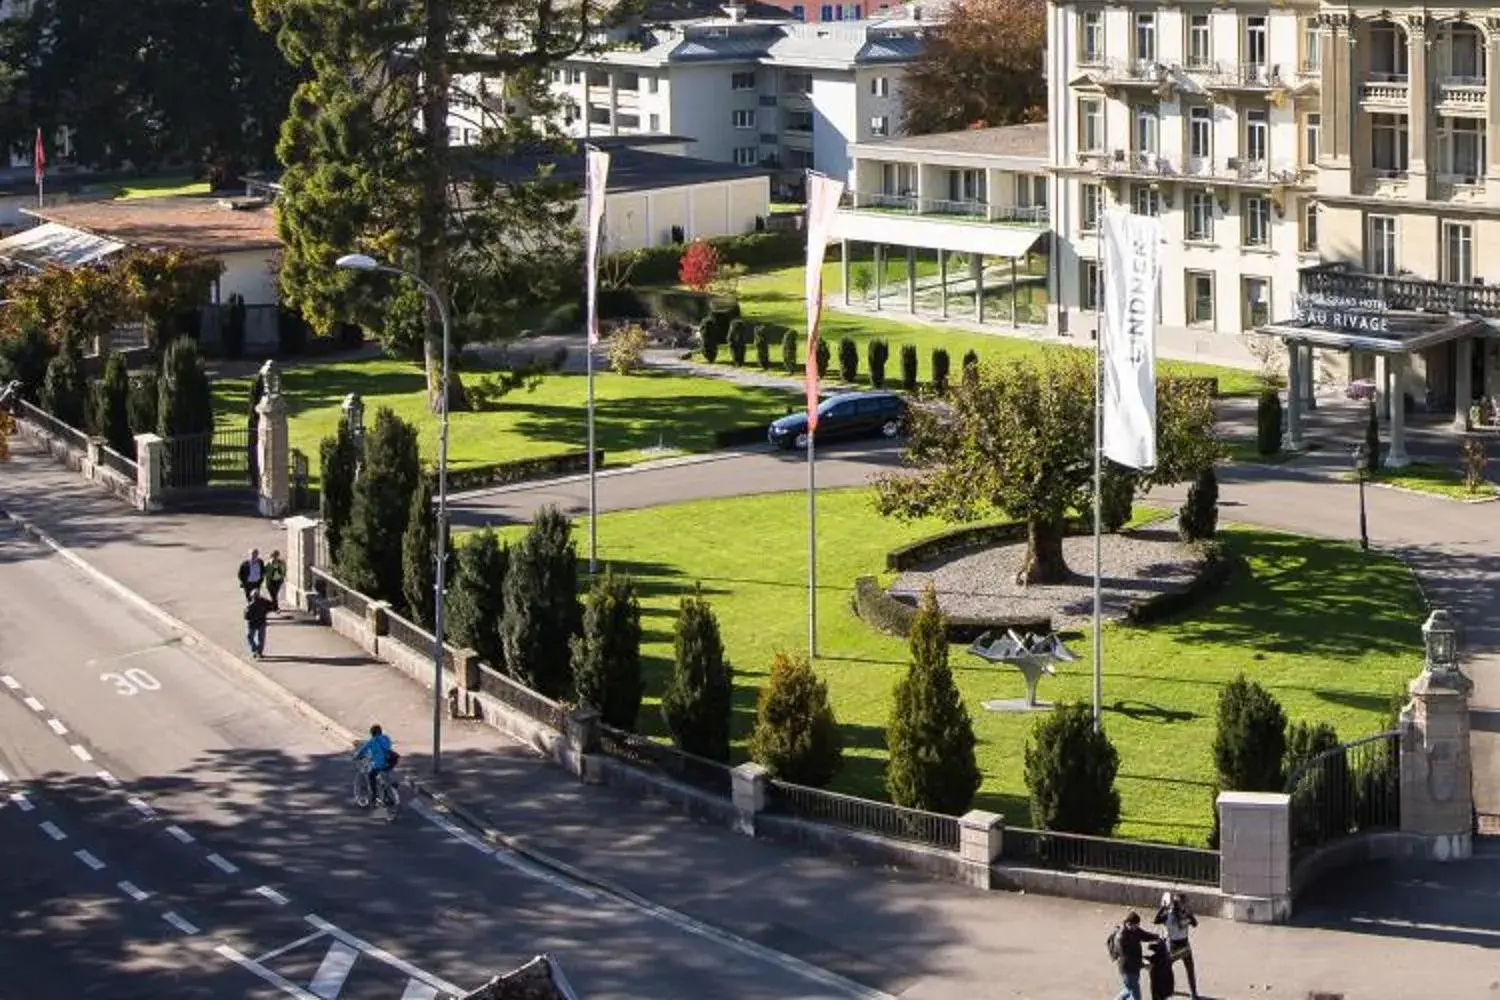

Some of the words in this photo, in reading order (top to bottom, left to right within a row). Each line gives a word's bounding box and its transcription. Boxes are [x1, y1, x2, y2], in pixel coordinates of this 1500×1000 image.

[1359, 298, 1388, 312] HOTEL
[1333, 312, 1388, 332] RIVAGE
[100, 668, 161, 696] 30
